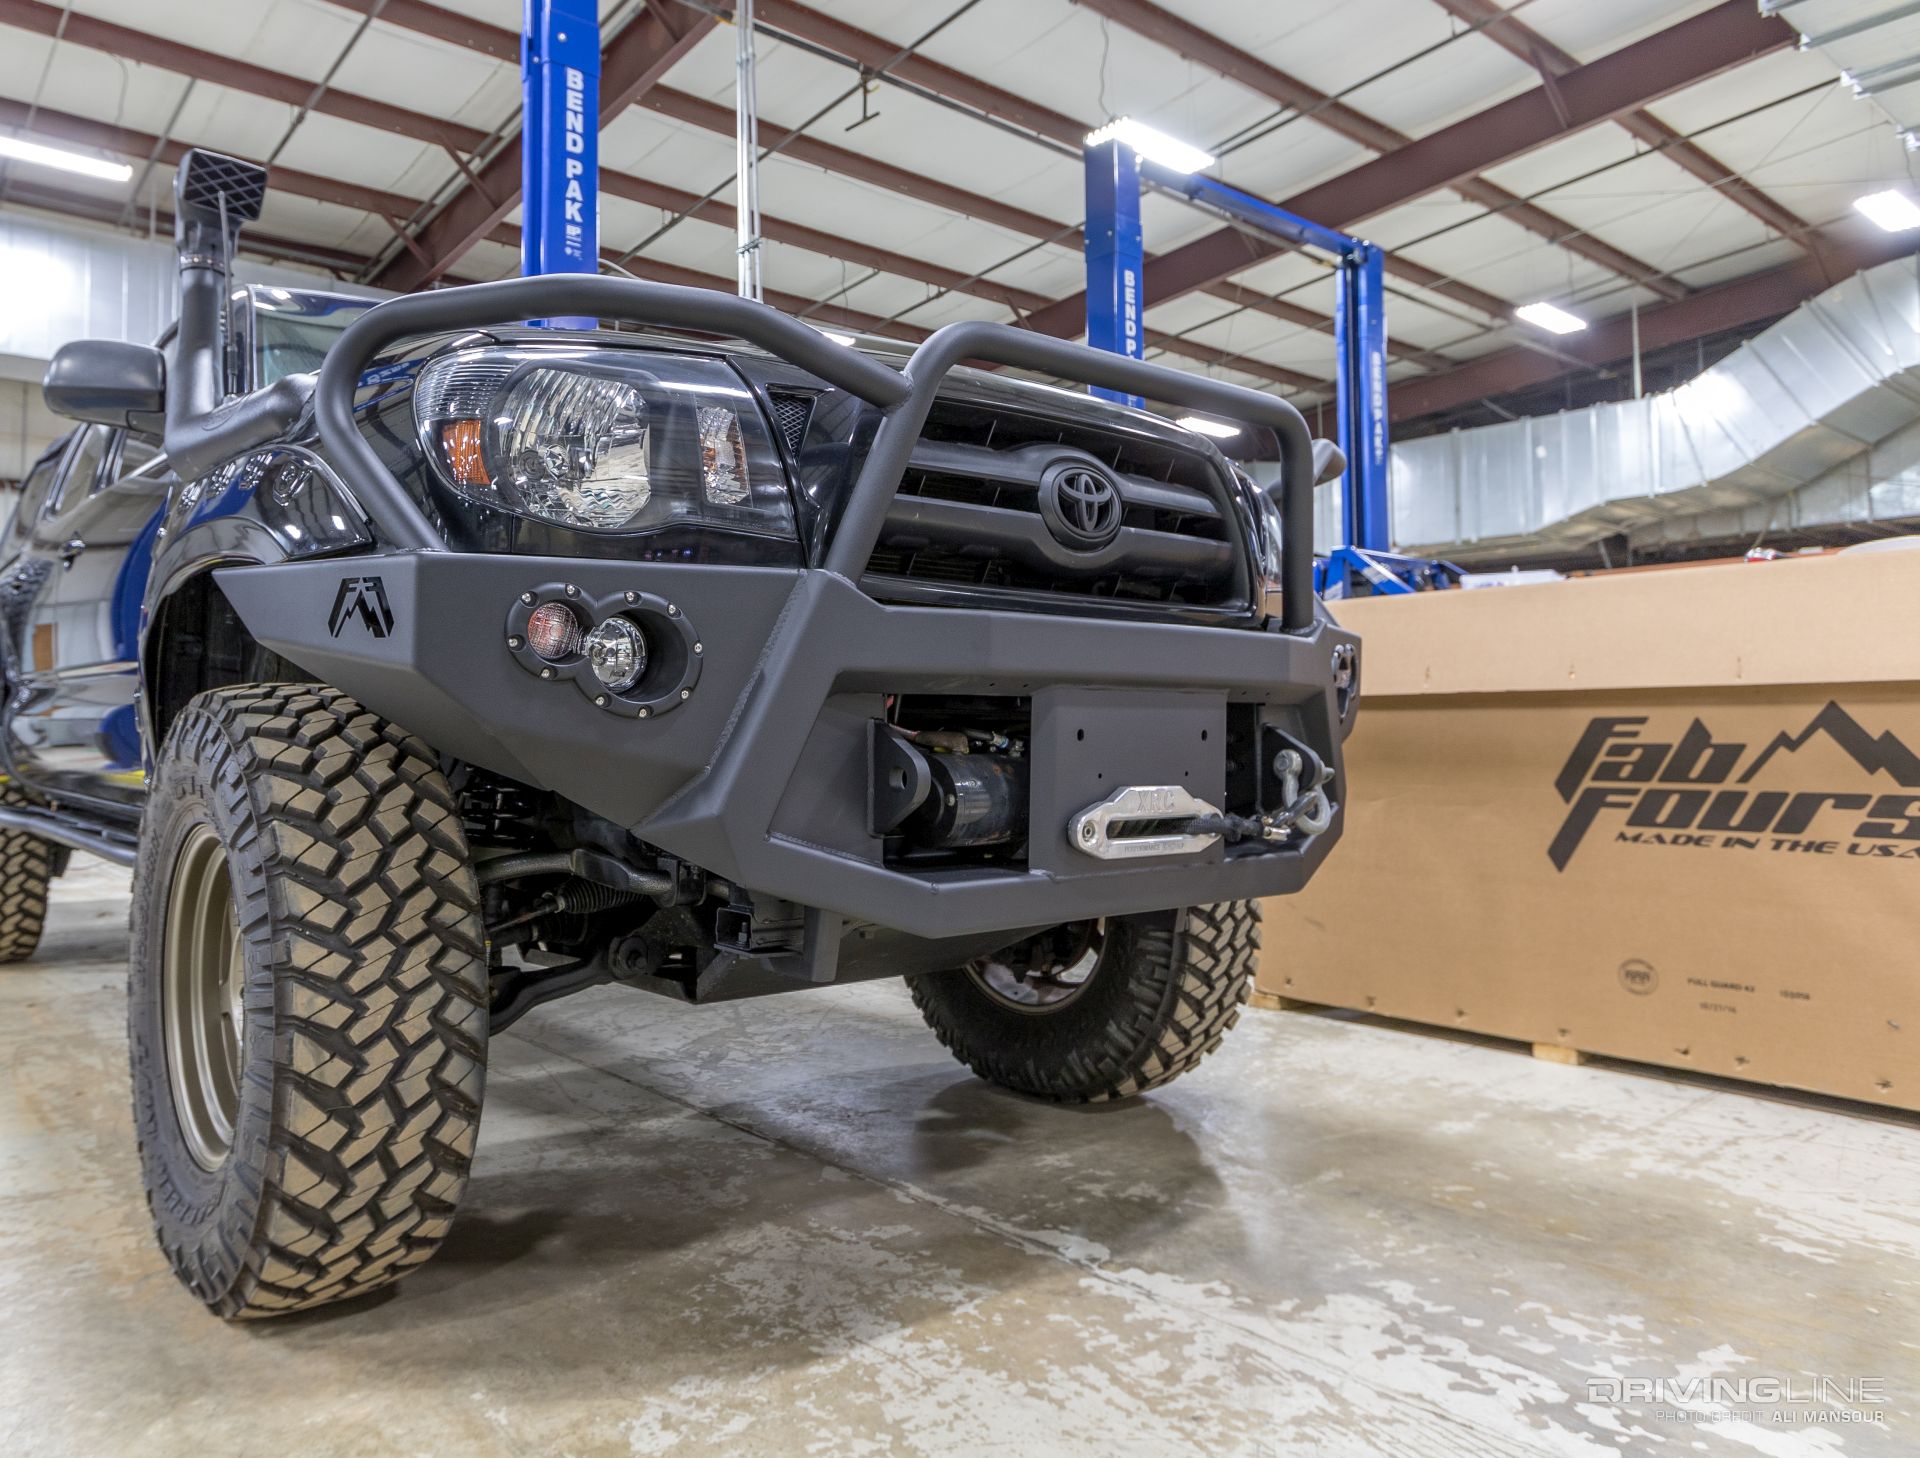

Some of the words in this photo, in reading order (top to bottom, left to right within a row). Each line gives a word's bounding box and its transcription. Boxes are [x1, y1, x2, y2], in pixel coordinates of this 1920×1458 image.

[1554, 716, 1747, 805] Fab
[1137, 790, 1175, 813] XRC
[1615, 831, 1714, 848] MADE
[1721, 837, 1762, 850] IN
[1771, 838, 1839, 855] THE
